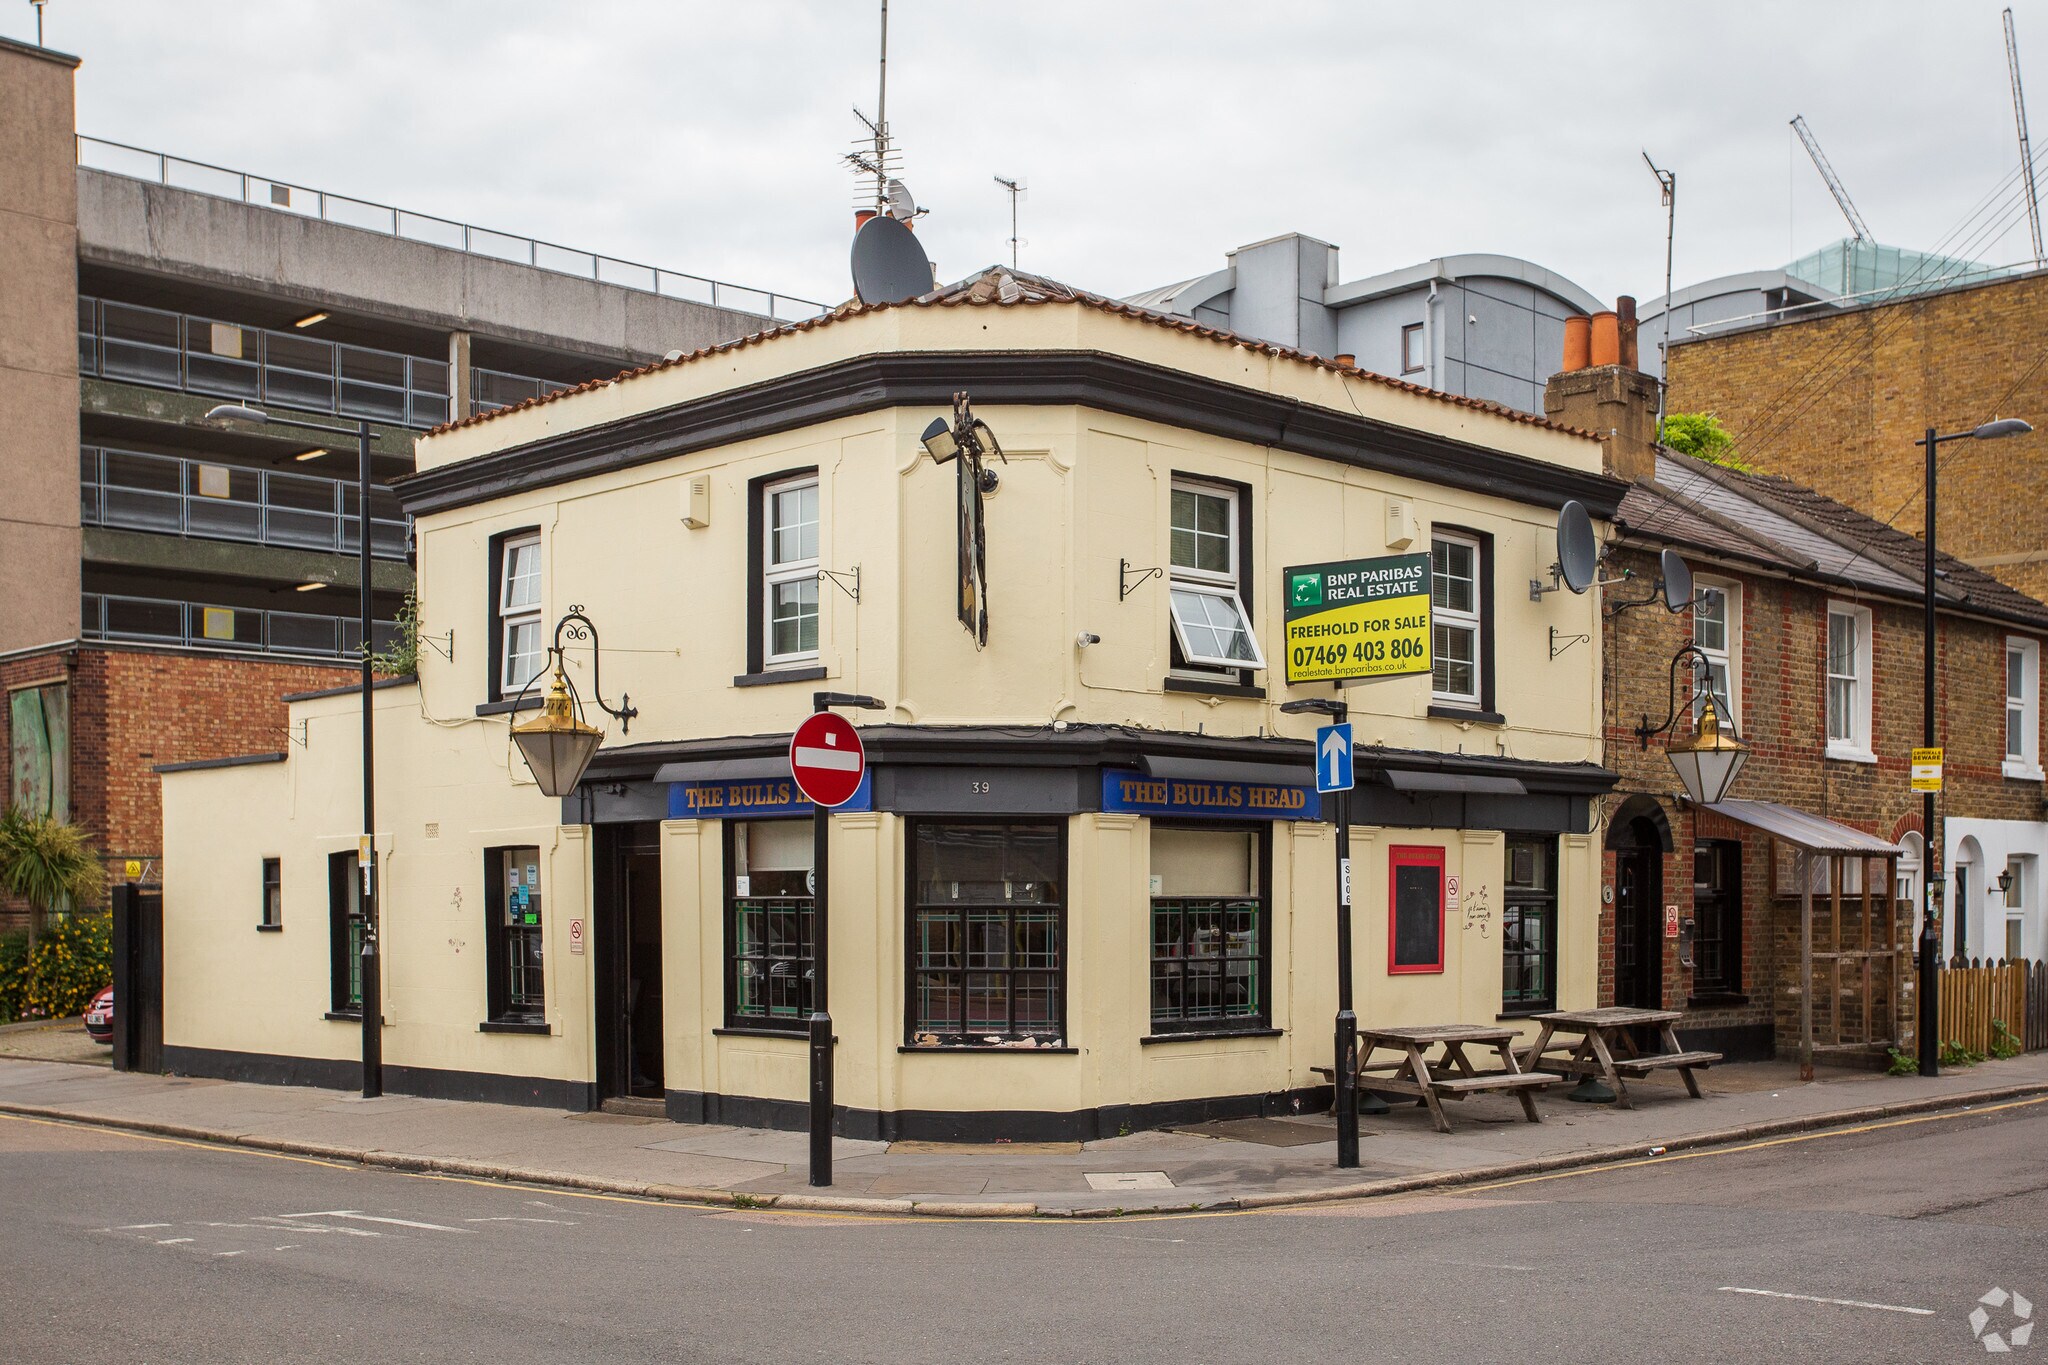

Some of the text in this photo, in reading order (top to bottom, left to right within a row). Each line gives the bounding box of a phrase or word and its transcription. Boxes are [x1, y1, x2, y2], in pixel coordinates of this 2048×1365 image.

[1327, 565, 1423, 587] BNP PARIBAS
[1328, 580, 1419, 600] REAL ESTATE
[1291, 615, 1426, 639] FREEHOLD FOR SALE
[1293, 637, 1424, 667] 07469 403 806
[1293, 660, 1407, 678] realestate.bnpparibas.co.uk
[685, 786, 723, 808] THE
[729, 783, 790, 806] BULLS
[972, 781, 990, 794] 39
[1119, 780, 1305, 809] THE BULLS HEAD
